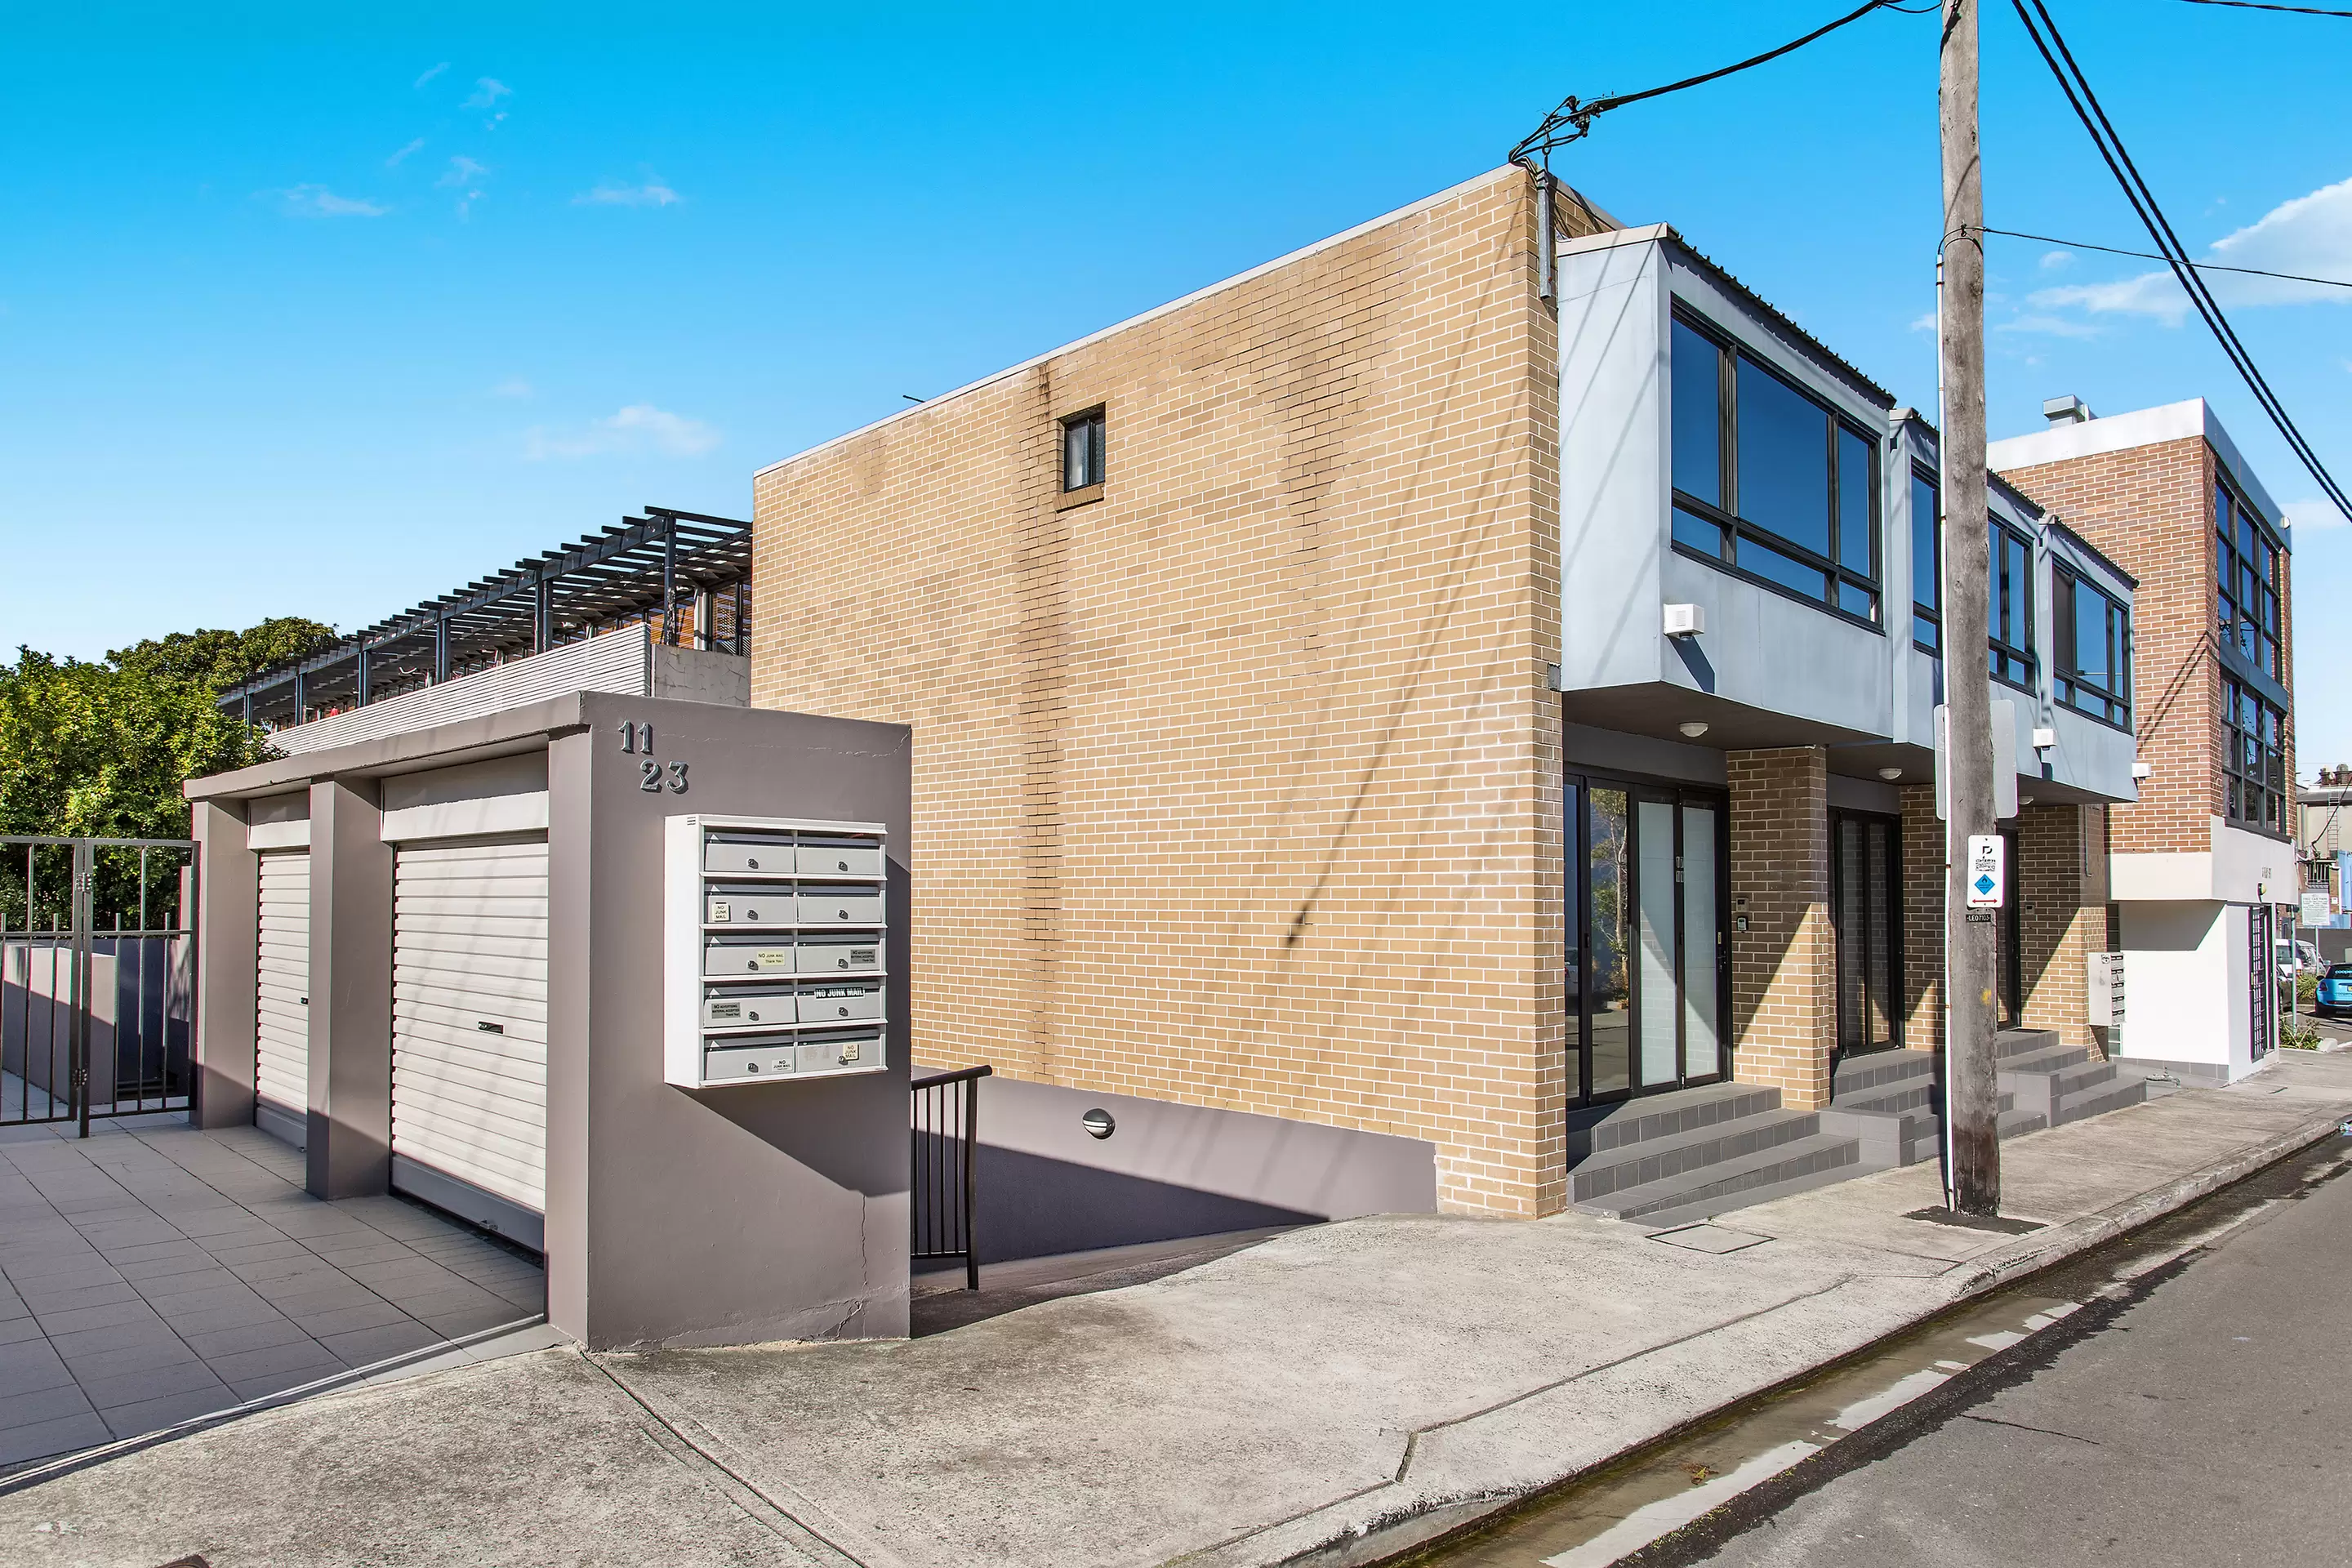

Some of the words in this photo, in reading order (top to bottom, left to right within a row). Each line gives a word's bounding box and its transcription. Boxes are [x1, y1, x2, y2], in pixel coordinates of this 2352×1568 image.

[618, 720, 653, 754] 11
[640, 760, 688, 794] 23
[817, 989, 826, 997] NO
[827, 988, 846, 997] JUNK
[847, 988, 863, 996] MAIL
